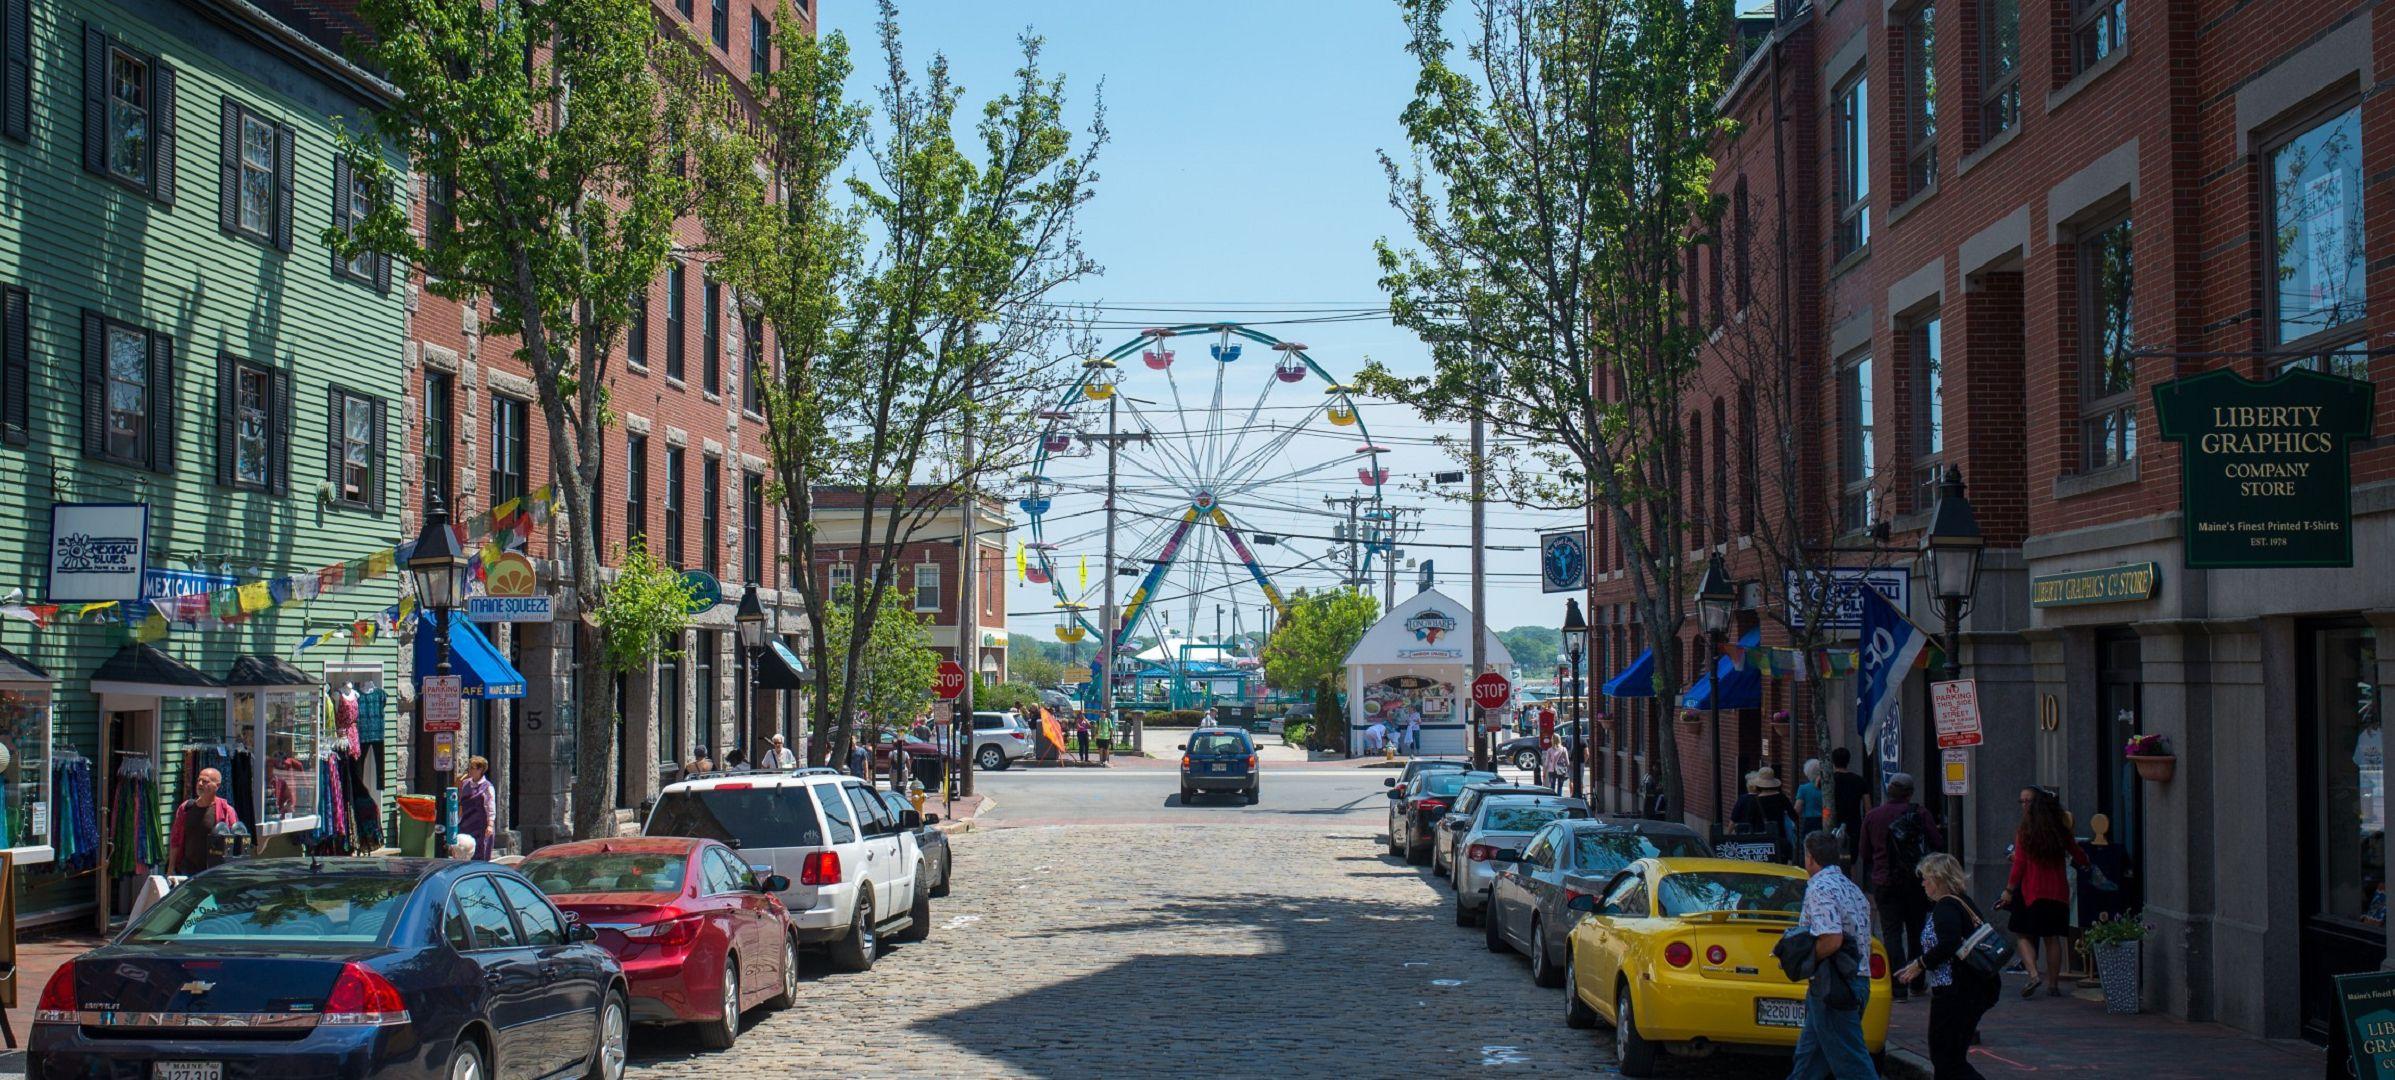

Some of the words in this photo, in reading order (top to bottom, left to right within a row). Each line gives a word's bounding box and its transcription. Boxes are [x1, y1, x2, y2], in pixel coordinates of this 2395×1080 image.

[2213, 406, 2322, 427] LIBERTY
[2201, 433, 2332, 454] GRAPHICS
[2225, 463, 2310, 478] COMPANY
[2241, 482, 2296, 496] STORE
[2198, 521, 2235, 531] Maine's
[2238, 521, 2266, 531] Finest
[2268, 520, 2301, 531] Printed
[2304, 520, 2339, 531] T-Shirts
[2250, 537, 2268, 546] EST.
[2270, 537, 2287, 546] 1978
[92, 544, 138, 555] MEXICALI
[94, 555, 126, 564] BLUES
[2033, 580, 2064, 603] LIBERTY
[2066, 575, 2104, 600] GRAPHICS
[2120, 570, 2149, 595] STORE
[470, 598, 504, 613] MAINE
[505, 598, 549, 614] SQUEEZE
[938, 674, 963, 687] TOP
[1475, 683, 1507, 699] STOP
[1946, 686, 1960, 694] NO
[1936, 693, 1972, 702] PARKING
[1942, 711, 1969, 720] STREET
[2040, 692, 2058, 730] 10
[527, 710, 543, 730] 5
[1741, 847, 1775, 855] MEXICALI
[1767, 1005, 1790, 1019] 2260
